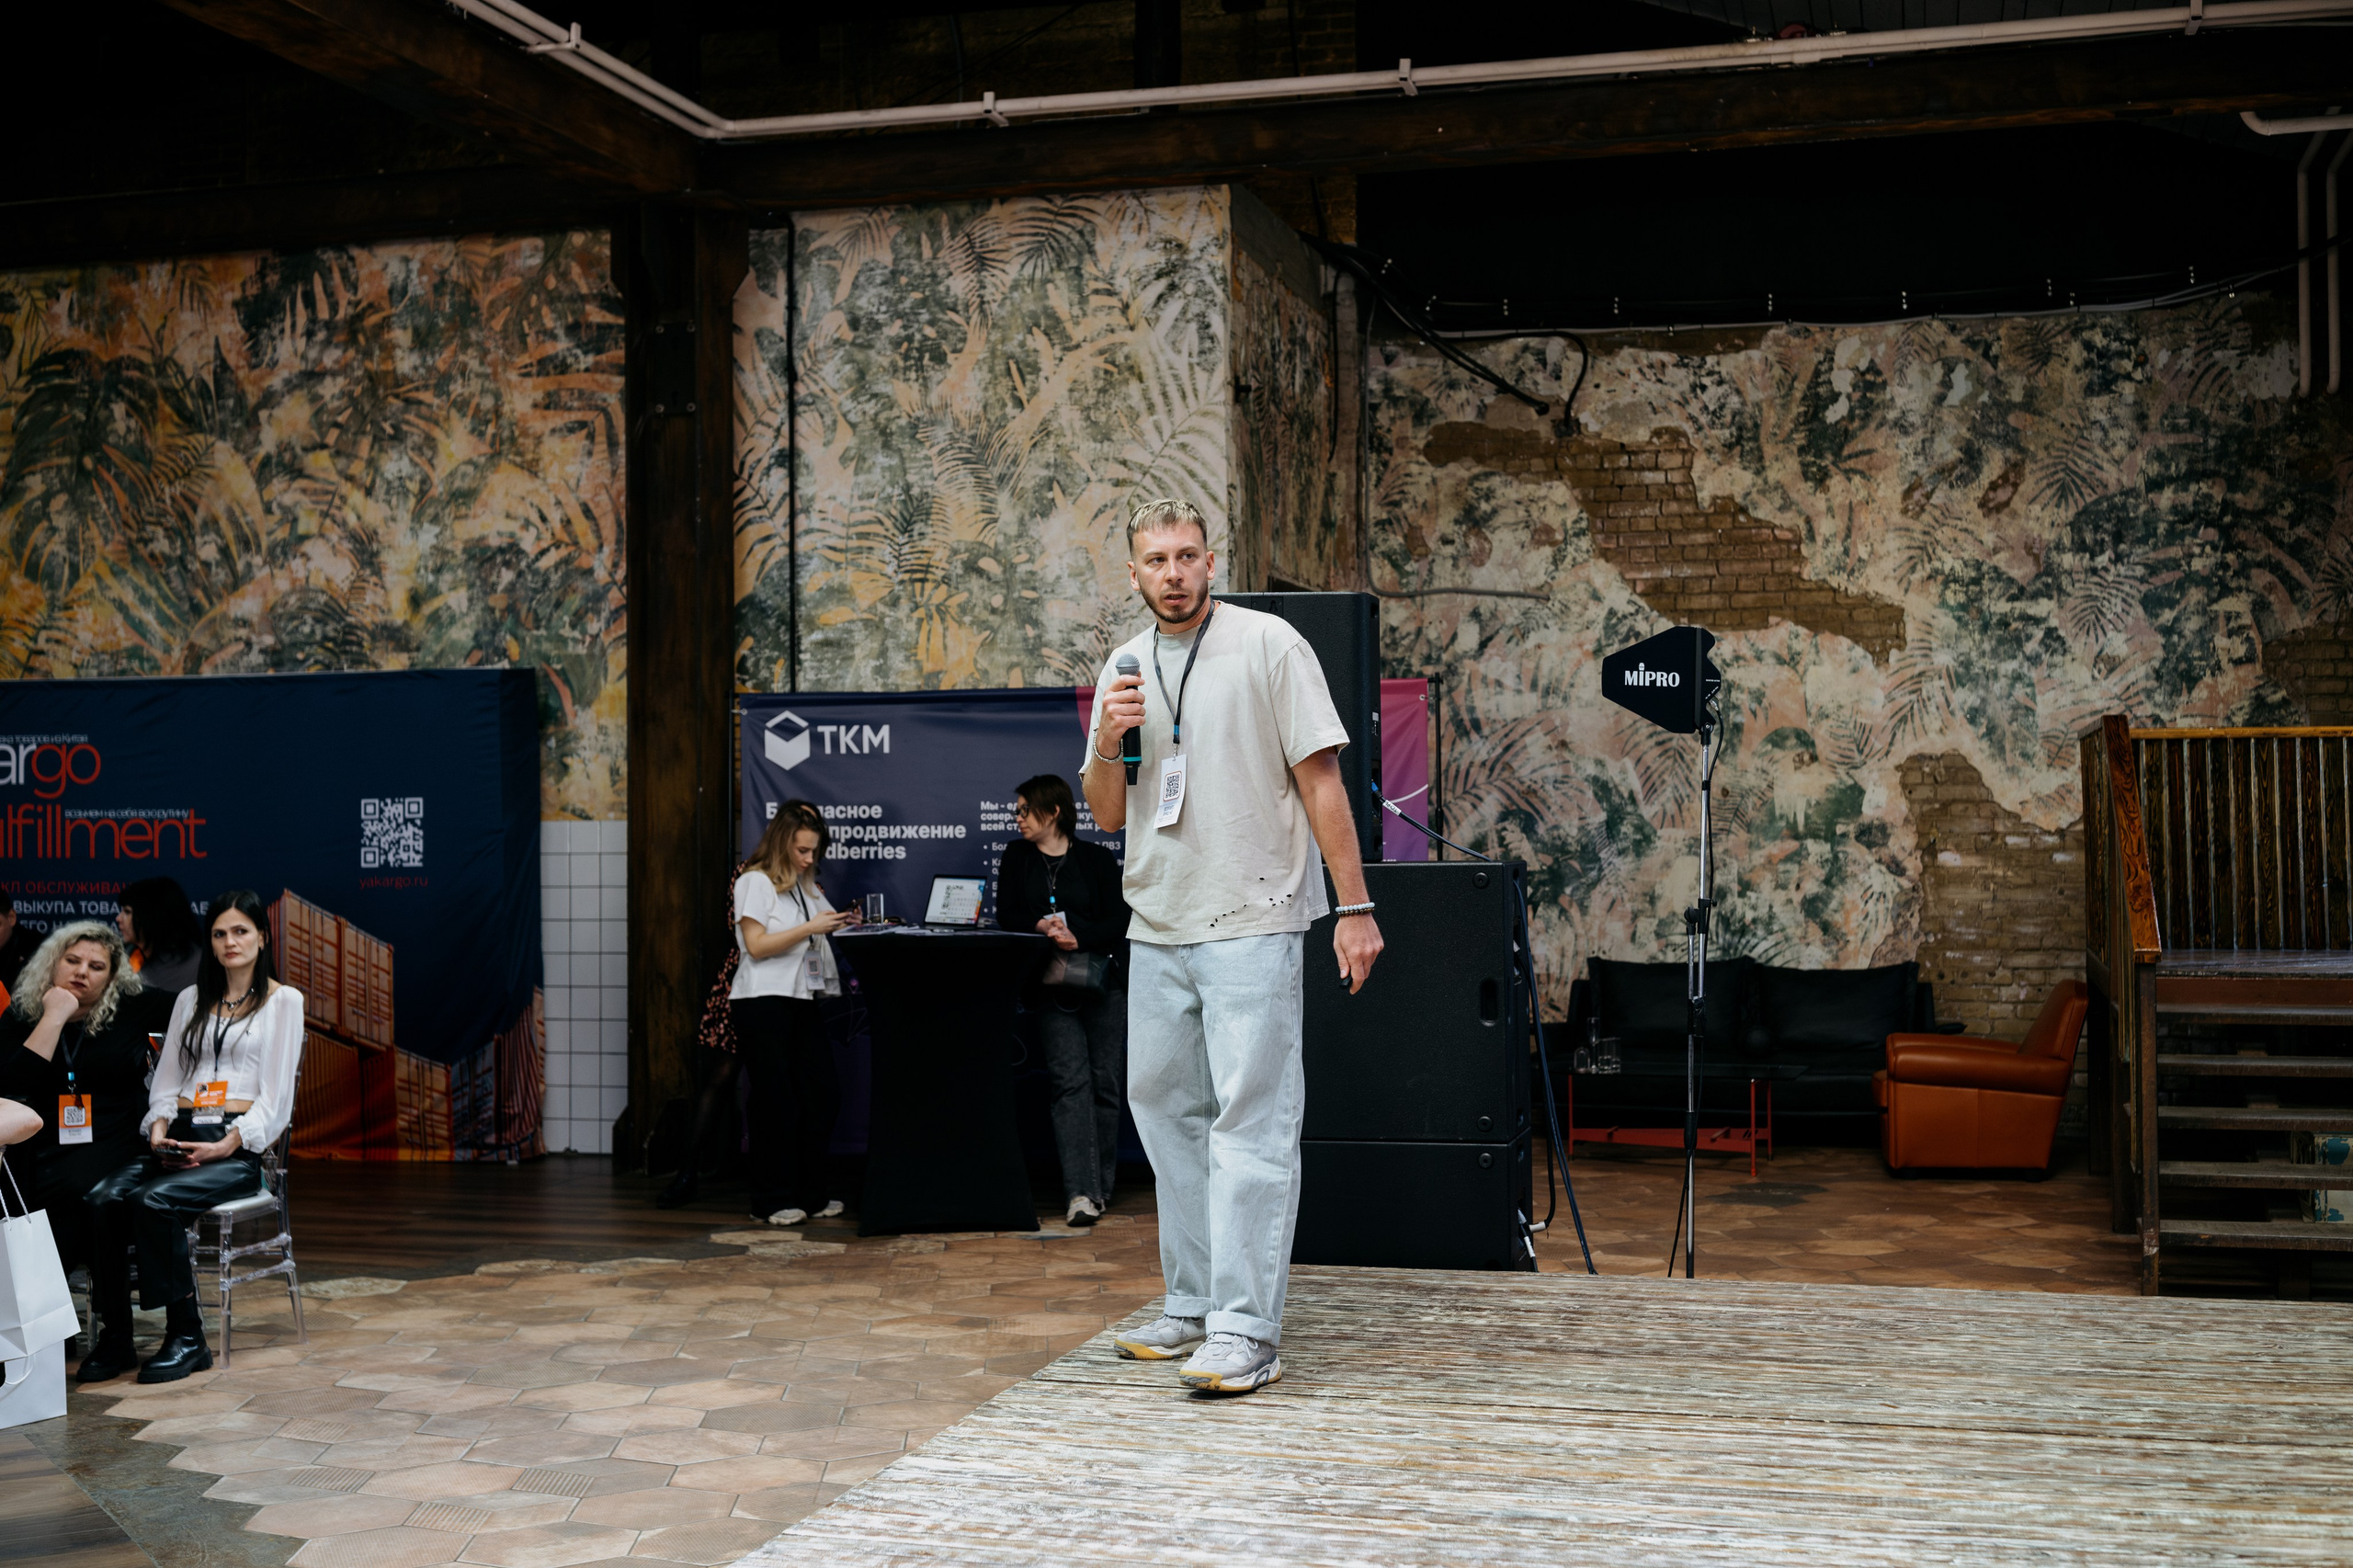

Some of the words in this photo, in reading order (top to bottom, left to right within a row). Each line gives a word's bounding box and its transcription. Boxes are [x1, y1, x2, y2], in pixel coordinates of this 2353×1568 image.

[981, 801, 998, 811] Мы
[981, 822, 1005, 831] всей
[359, 875, 428, 890] yakargo.ru
[13, 900, 75, 915] ВЫКУПА
